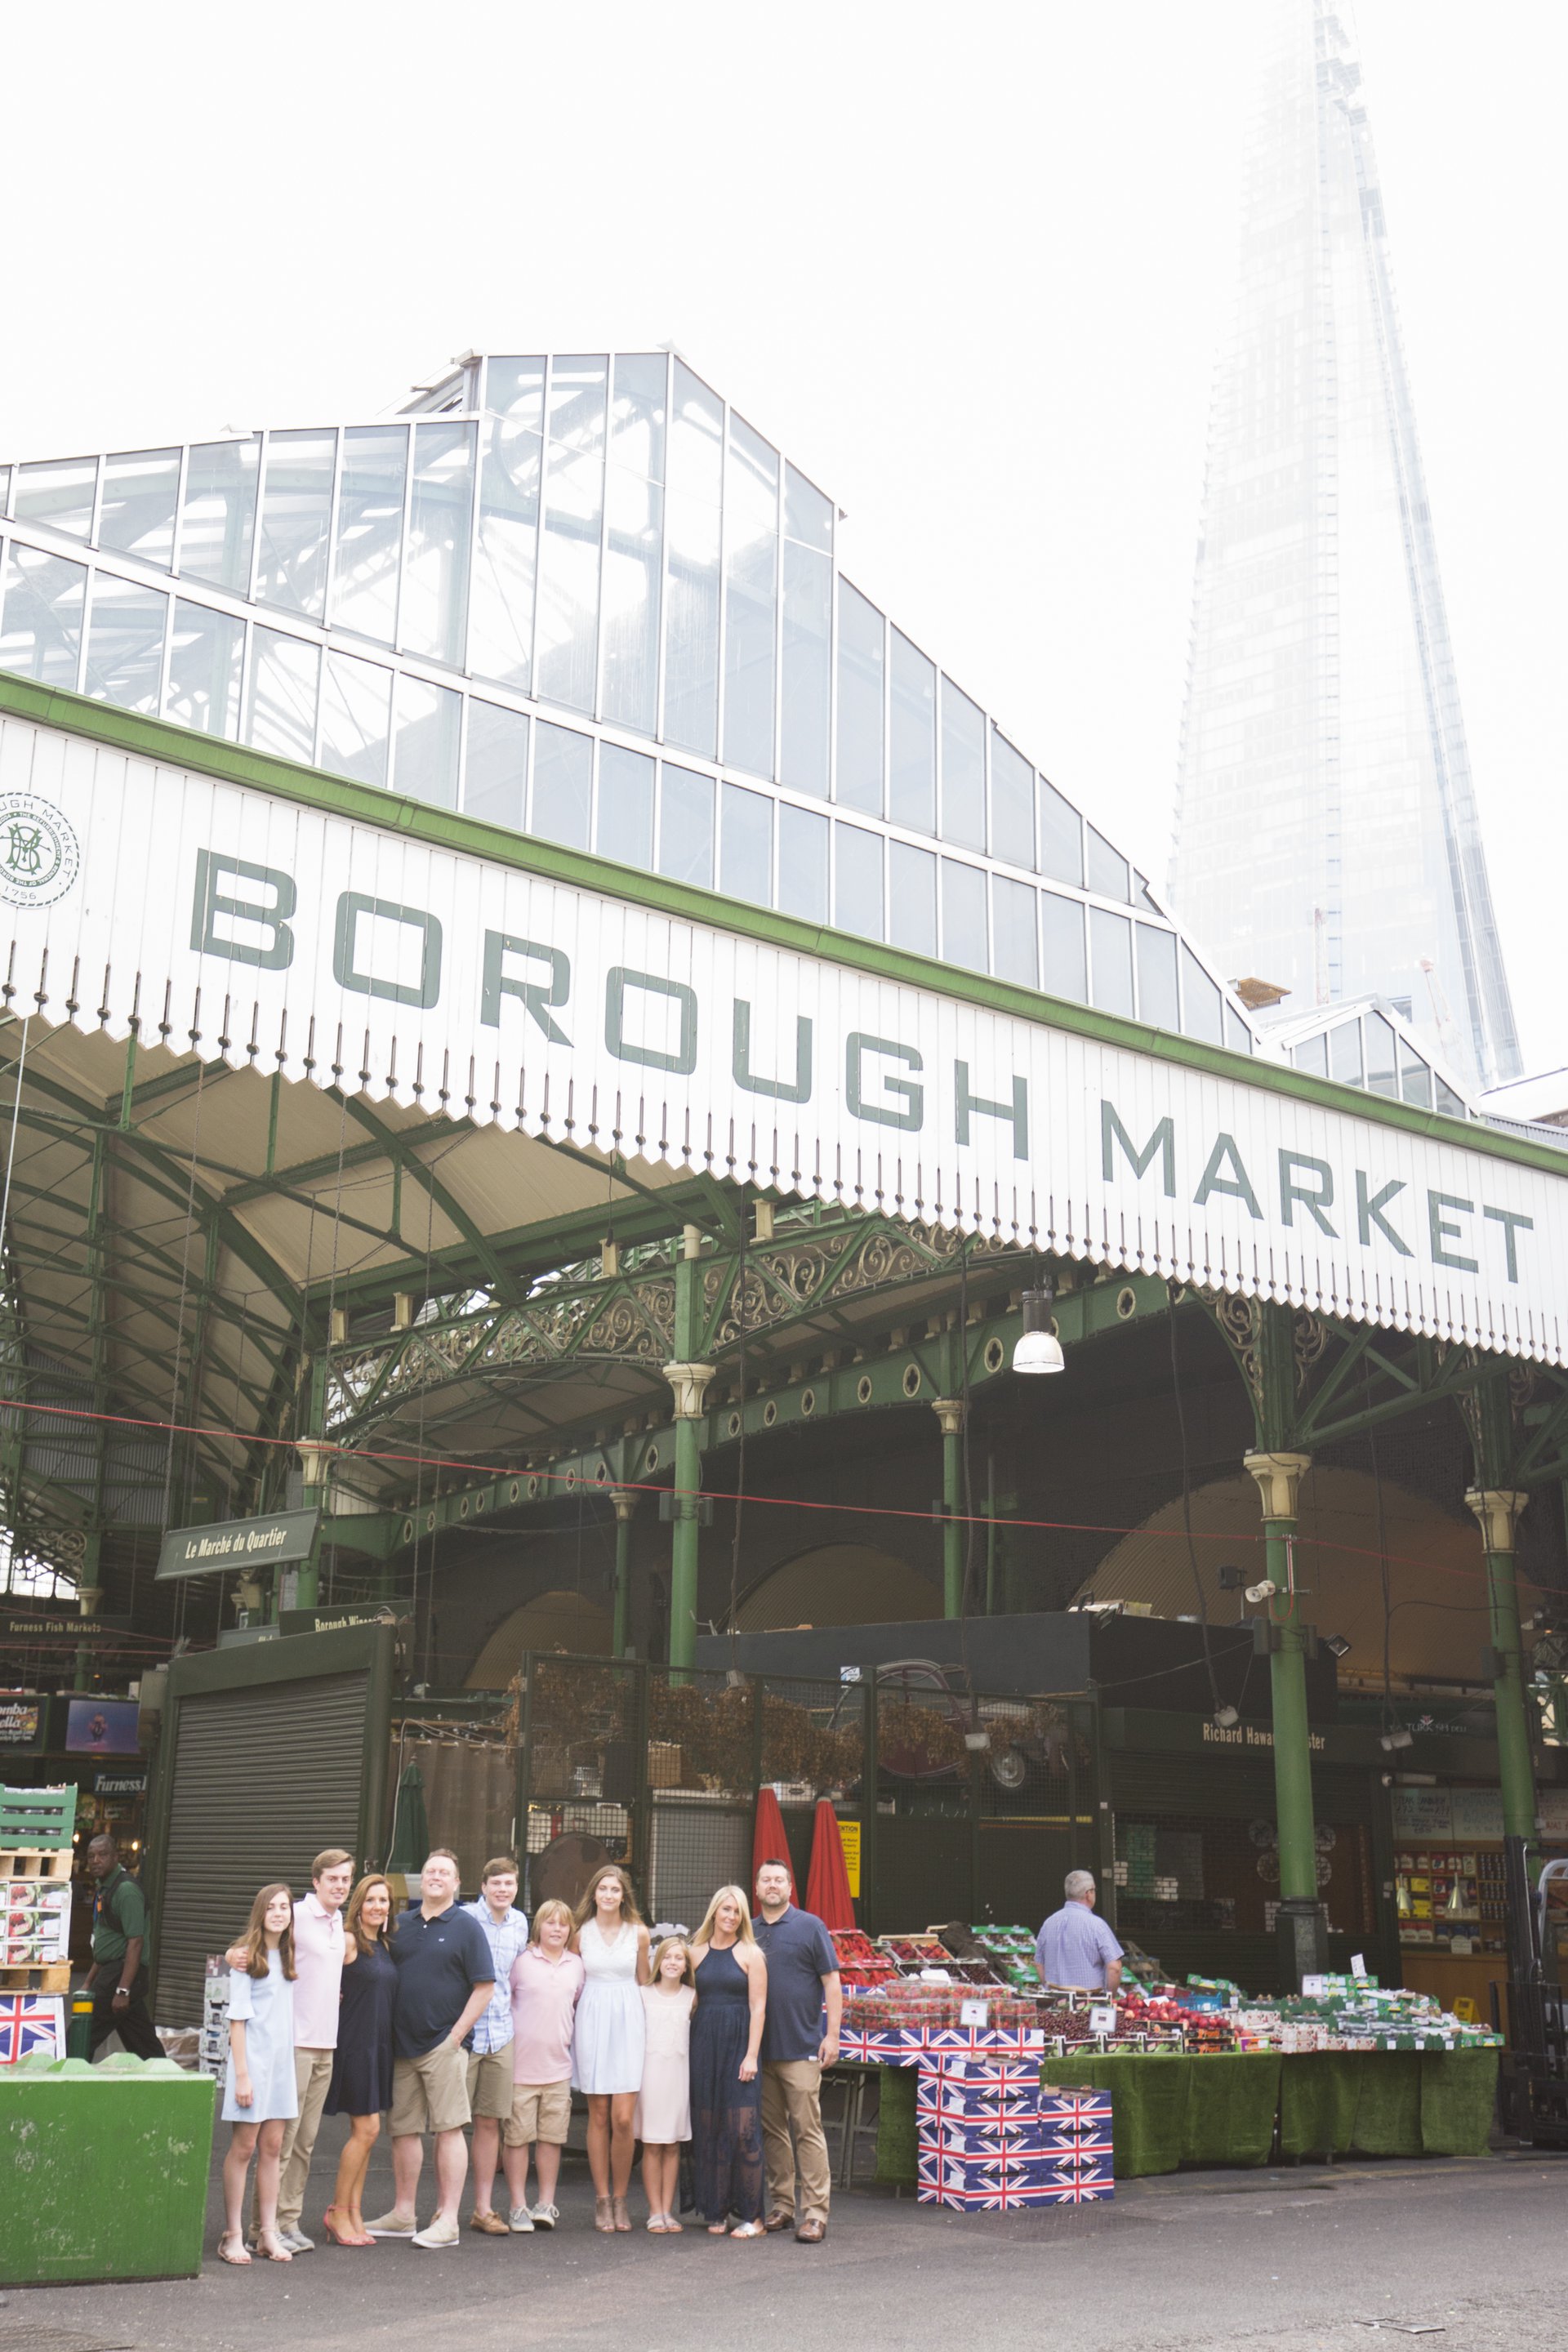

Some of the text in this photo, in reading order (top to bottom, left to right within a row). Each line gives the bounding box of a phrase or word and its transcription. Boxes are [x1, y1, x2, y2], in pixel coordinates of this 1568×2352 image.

[42, 809, 73, 878] MARKET
[5, 885, 37, 899] 1756
[189, 848, 1535, 1283] BOROUGH MARKET
[185, 1527, 287, 1559] Le Marché du Quartier
[10, 1622, 42, 1632] Furness
[46, 1622, 64, 1633] Fish
[1203, 1723, 1242, 1743] Richard
[95, 1775, 141, 1791] Furness
